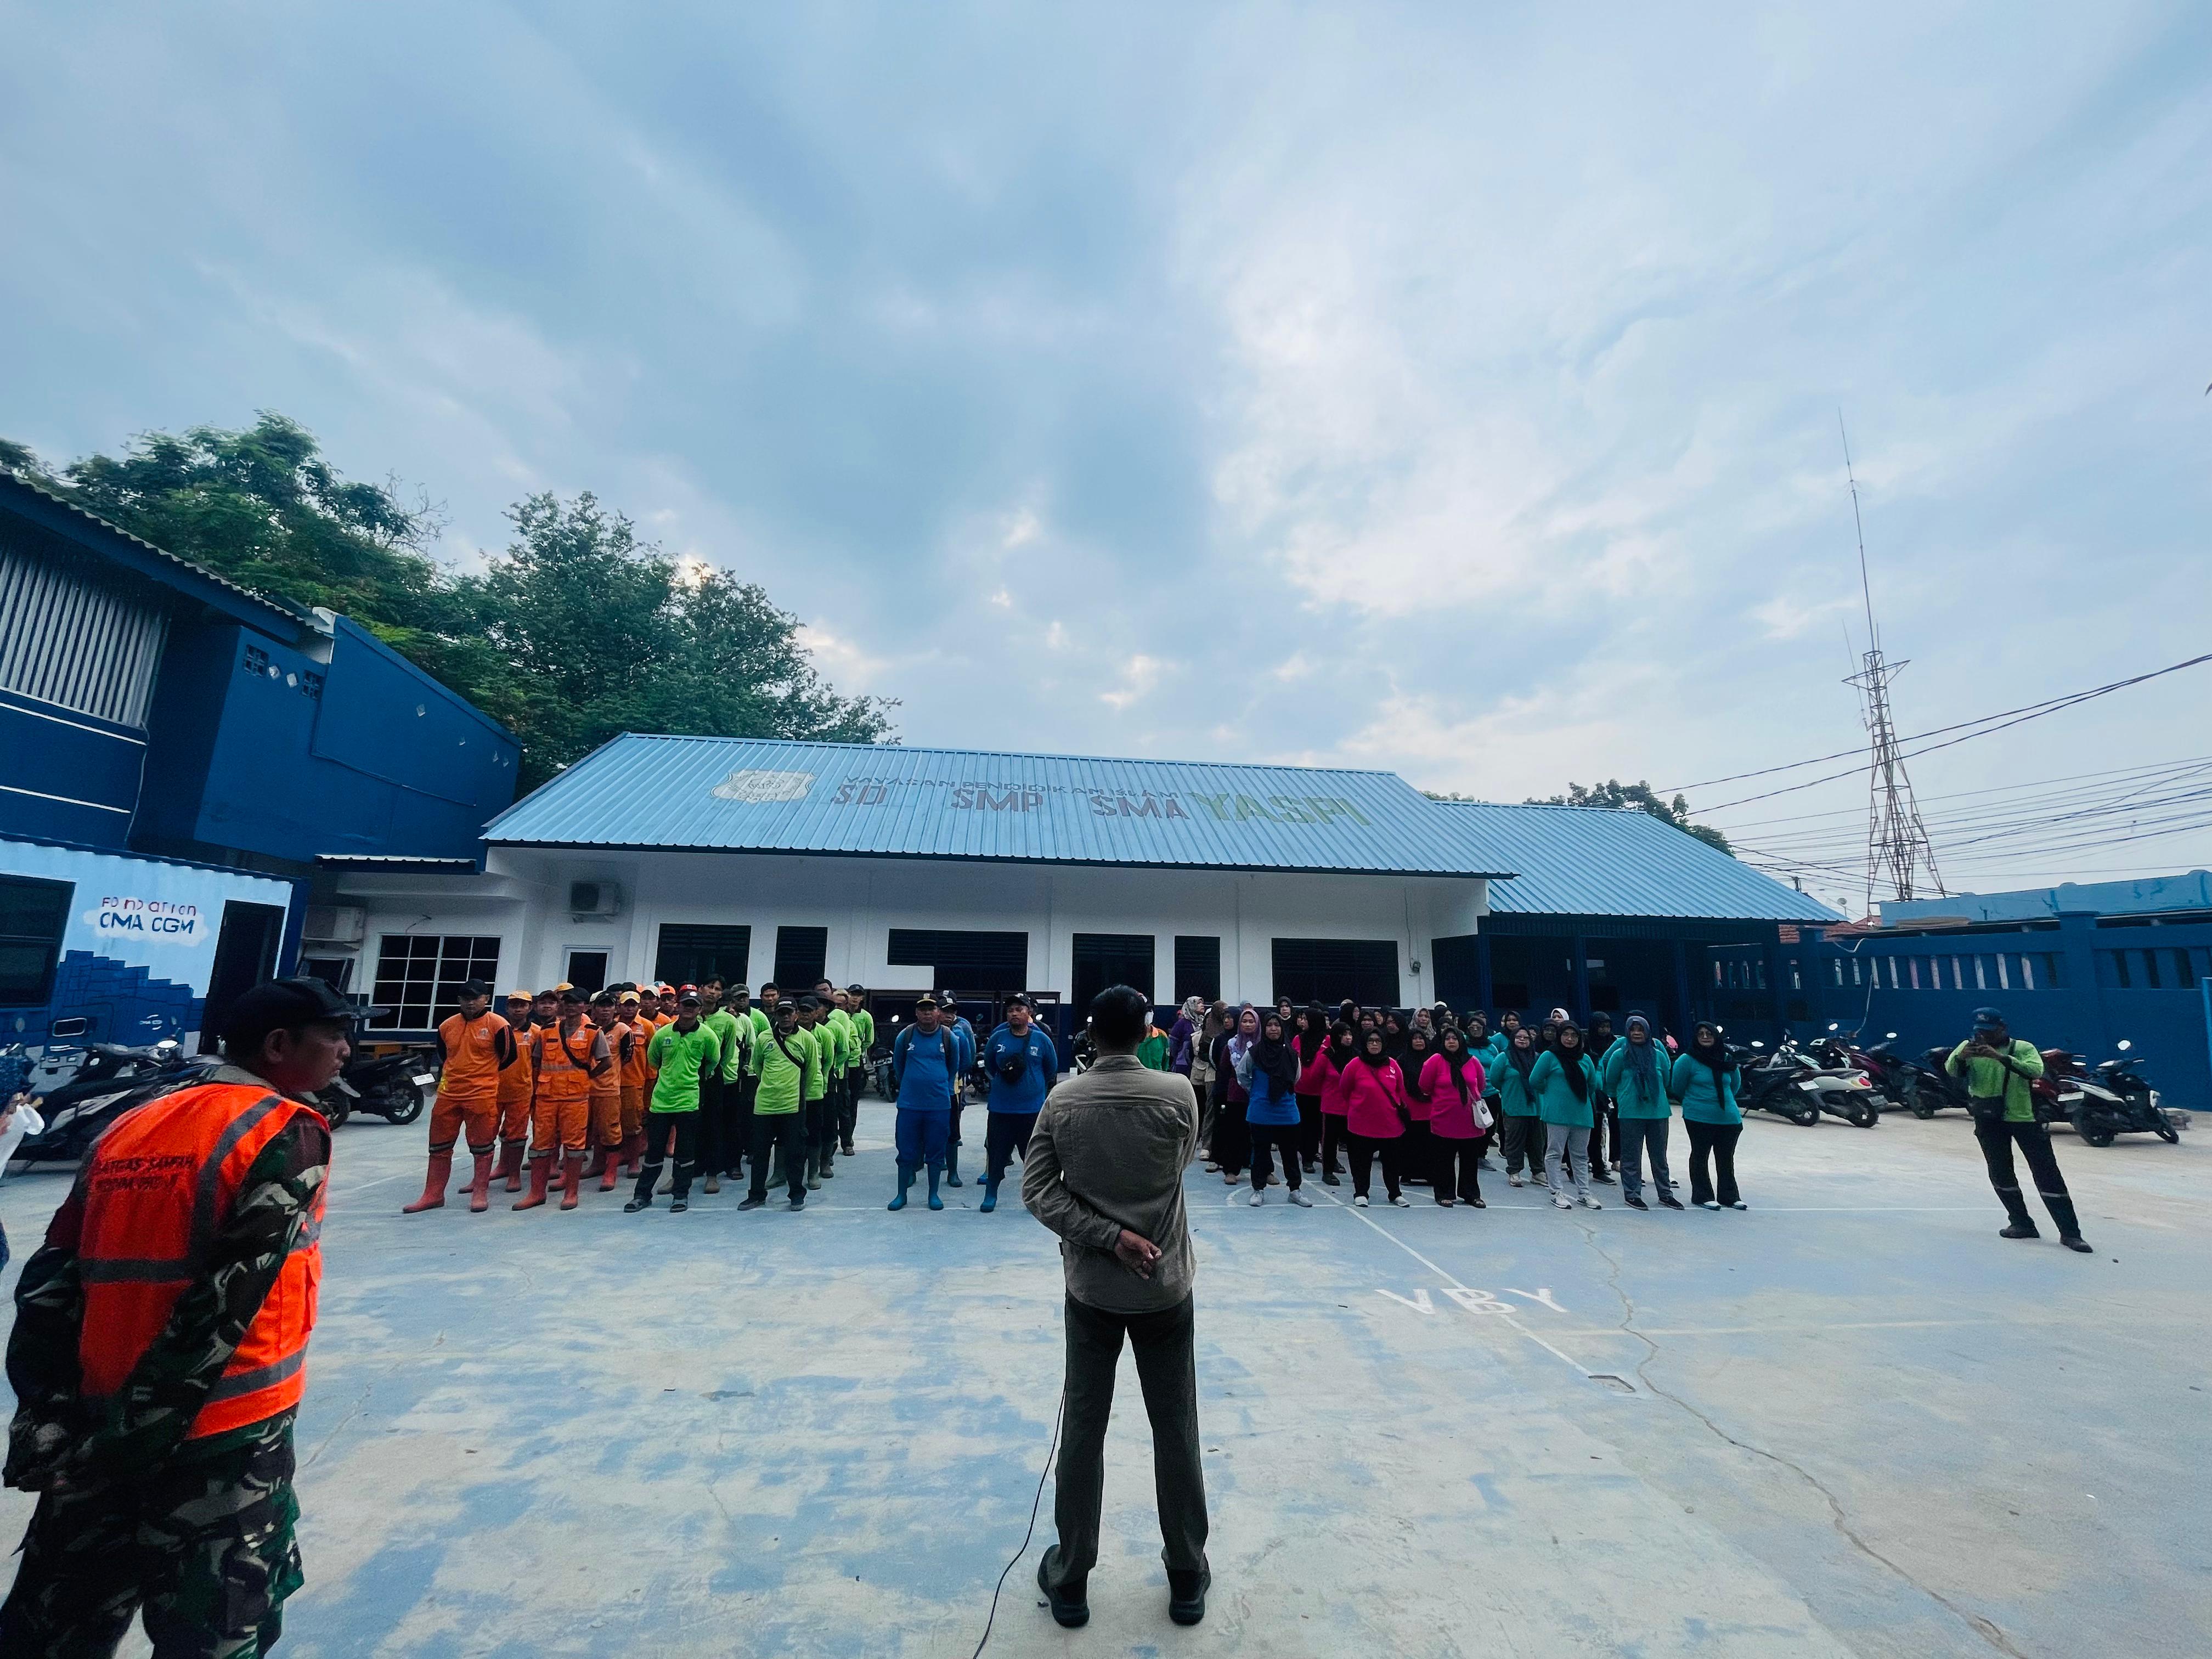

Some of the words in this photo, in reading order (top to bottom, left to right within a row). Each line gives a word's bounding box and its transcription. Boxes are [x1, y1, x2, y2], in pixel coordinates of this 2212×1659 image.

[962, 782, 1104, 794] PENDIDIKAN
[830, 785, 888, 805] SD
[951, 788, 1043, 812] SMP
[1091, 795, 1190, 820] SMA
[1185, 792, 1373, 826] YASPI
[100, 912, 144, 931] CMA
[151, 917, 195, 934] CGM
